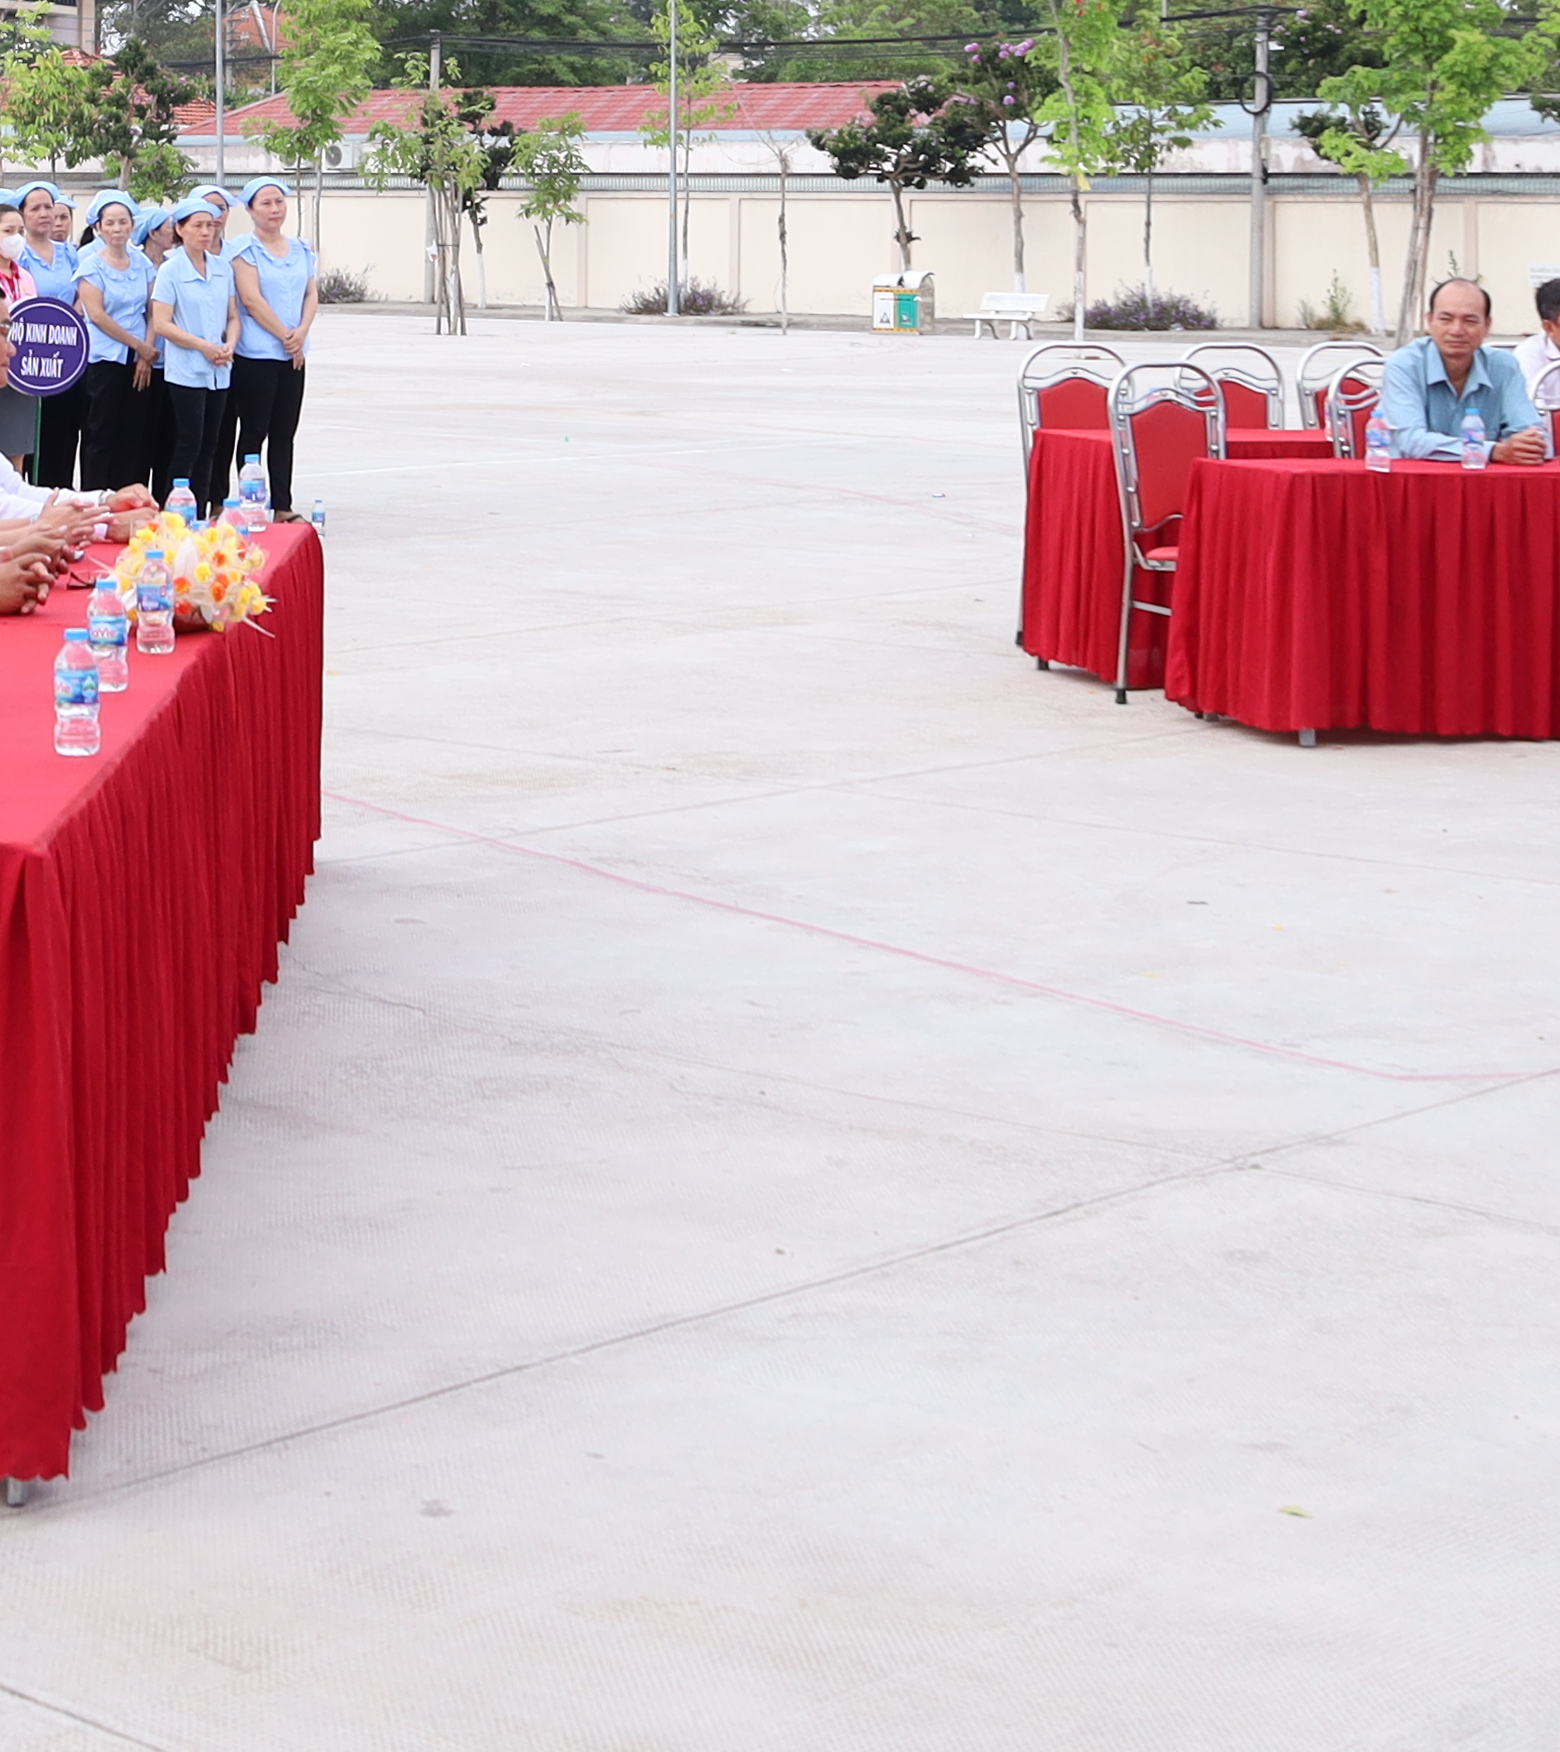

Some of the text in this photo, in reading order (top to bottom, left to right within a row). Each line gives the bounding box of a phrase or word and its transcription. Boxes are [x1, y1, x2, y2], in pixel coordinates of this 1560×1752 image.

[11, 316, 78, 346] HỘ KINH DOANH
[20, 348, 64, 378] SẢN XUẤT
